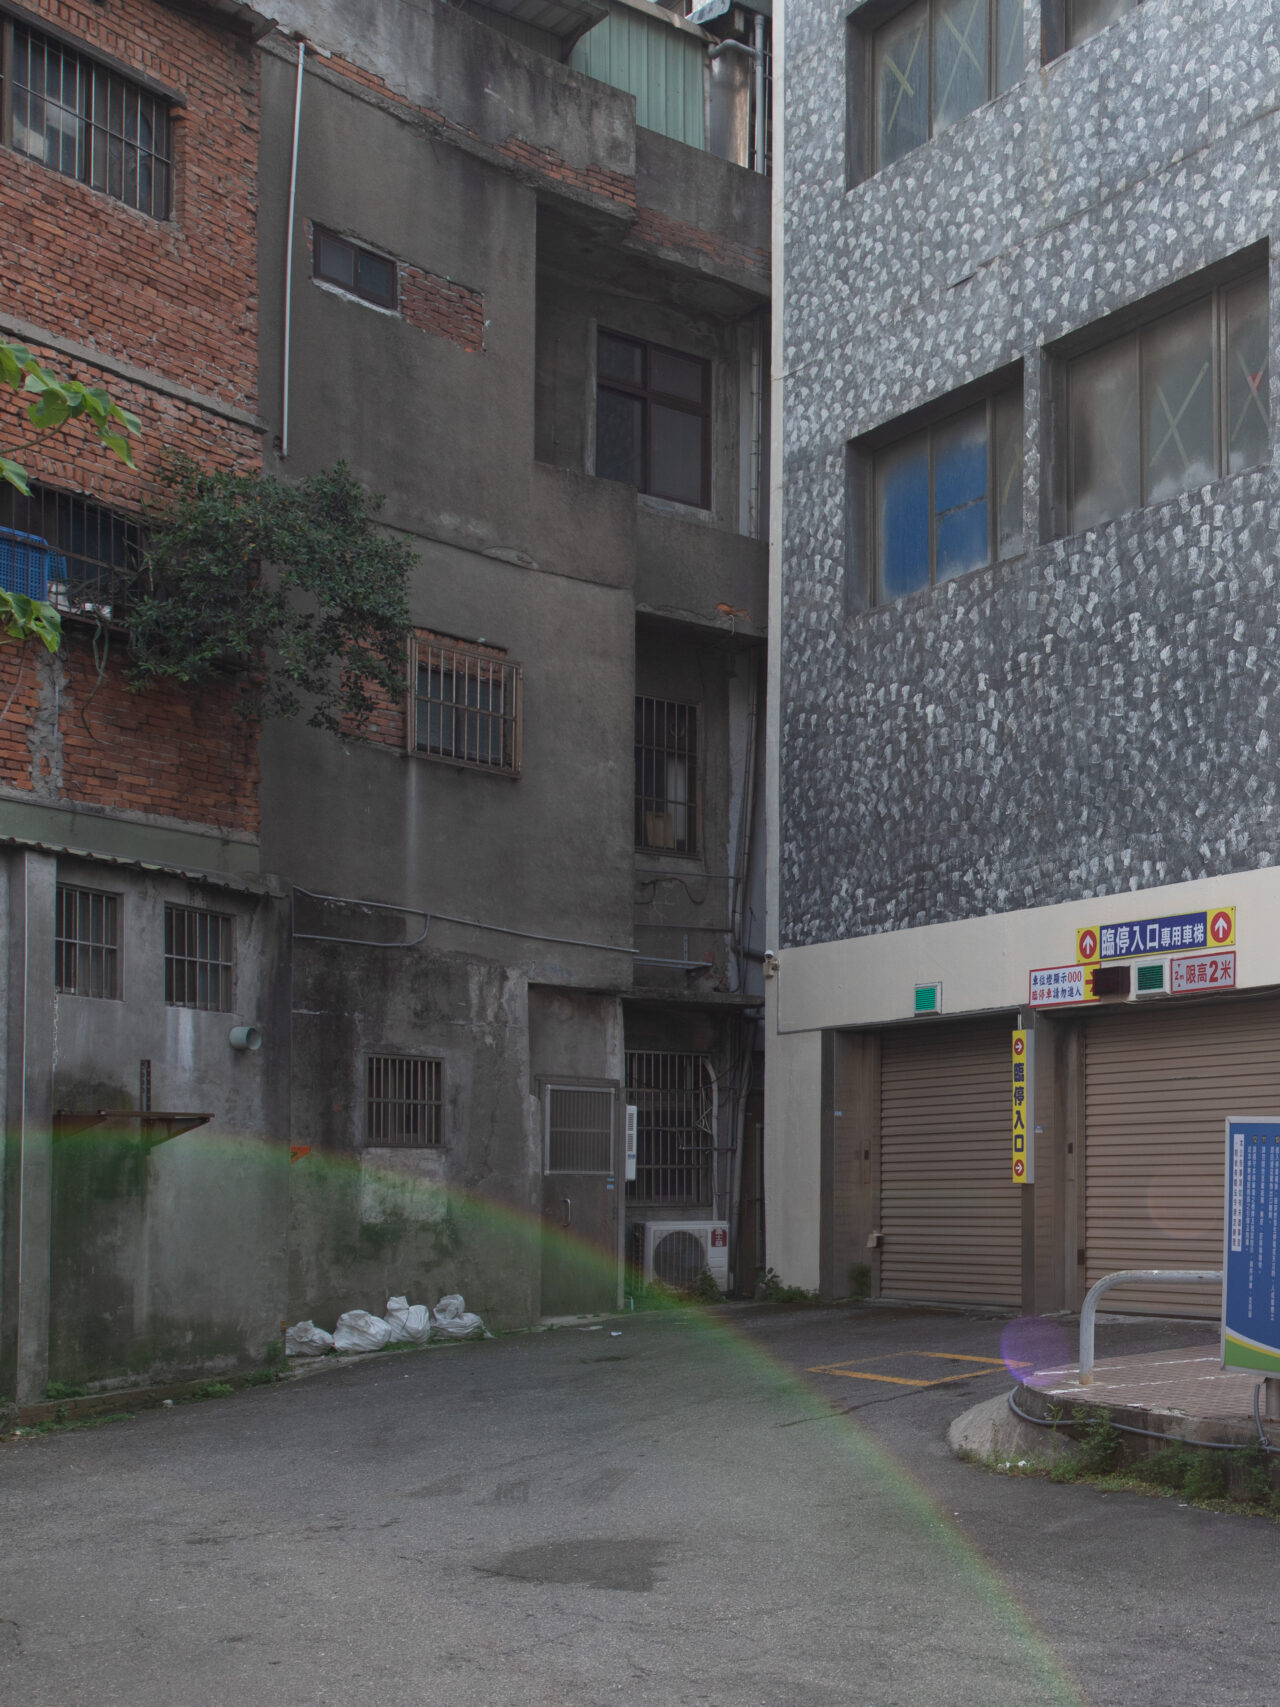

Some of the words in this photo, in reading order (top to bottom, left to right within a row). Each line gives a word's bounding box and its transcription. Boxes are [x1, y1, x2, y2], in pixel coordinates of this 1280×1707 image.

[1186, 959, 1232, 984] 限高2米
[1013, 1062, 1025, 1153] 臨停入口
